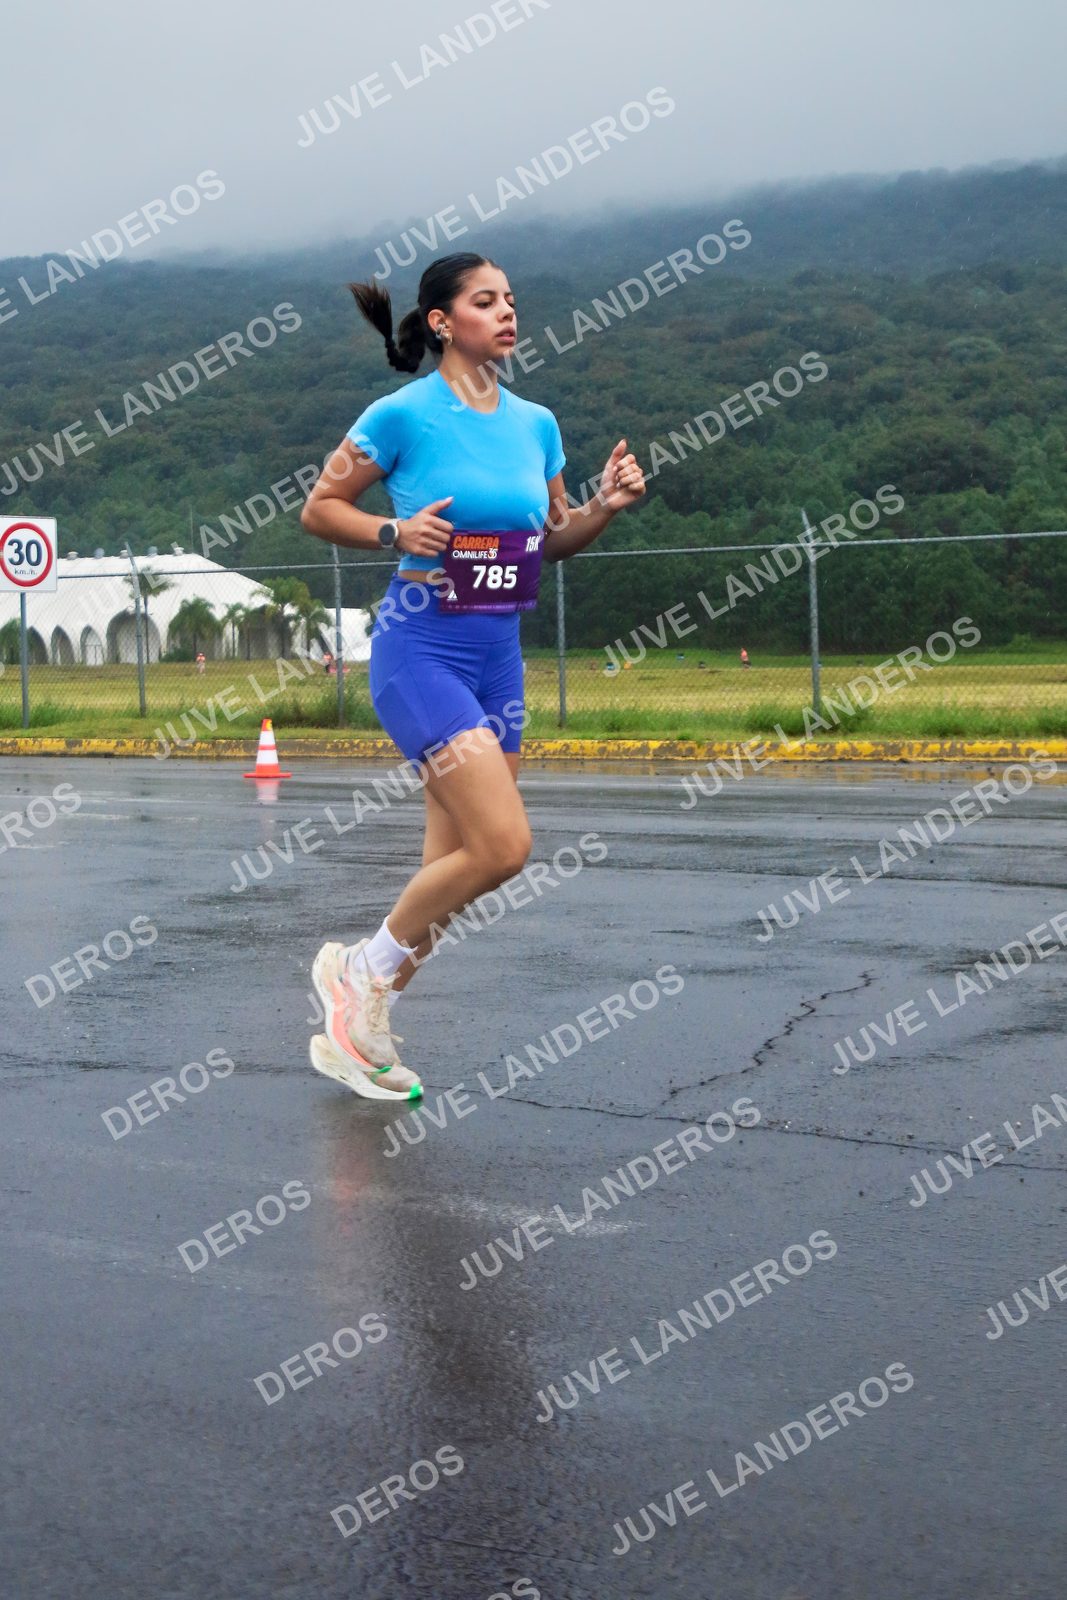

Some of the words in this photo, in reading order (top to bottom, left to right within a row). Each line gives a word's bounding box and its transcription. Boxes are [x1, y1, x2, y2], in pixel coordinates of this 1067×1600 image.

[7, 537, 43, 567] 30
[525, 535, 542, 552] 15K
[452, 550, 488, 559] OMNILIFE
[472, 564, 518, 589] 785
